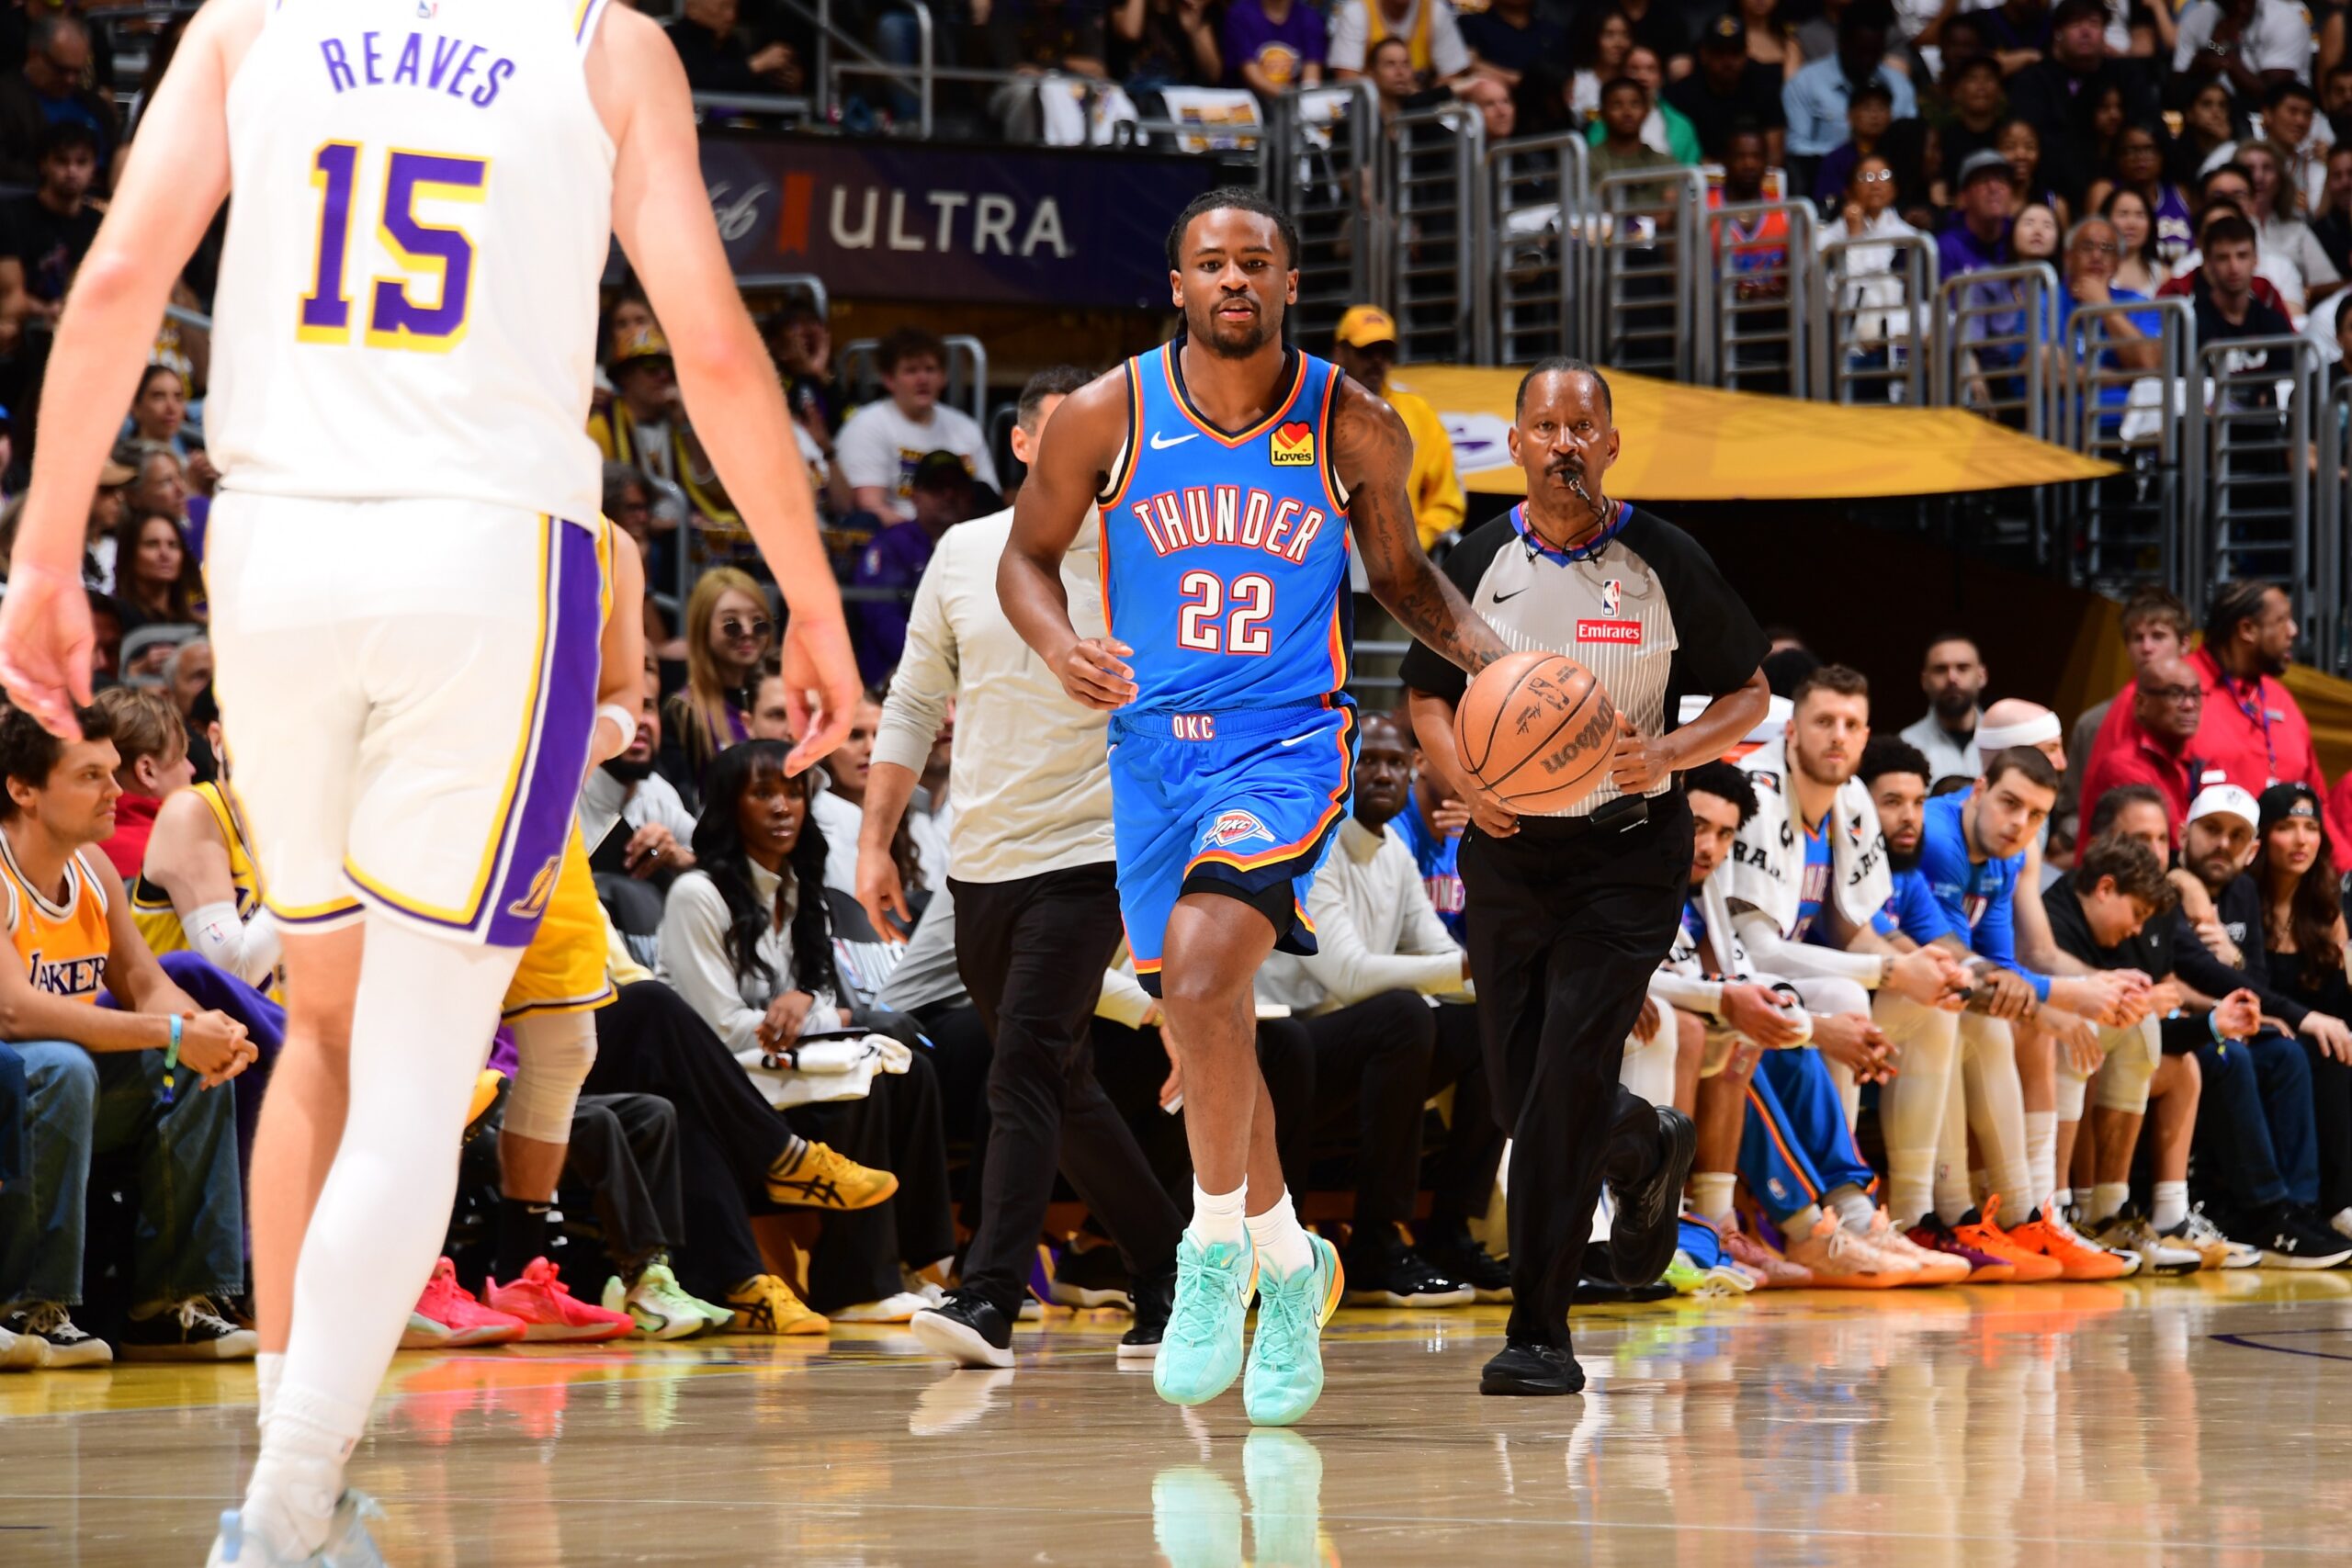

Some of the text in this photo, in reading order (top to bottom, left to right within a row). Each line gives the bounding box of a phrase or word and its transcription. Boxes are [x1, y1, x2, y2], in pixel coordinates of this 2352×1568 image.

[320, 30, 517, 108] REAVES
[296, 138, 492, 354] 15
[829, 185, 1069, 258] ULTRA
[1132, 485, 1326, 565] THUNDER
[1178, 570, 1275, 656] 22
[1577, 625, 1640, 640] Emirates
[1172, 713, 1215, 741] OKC
[1539, 695, 1615, 775] Wilson
[29, 952, 107, 996] LAKER
